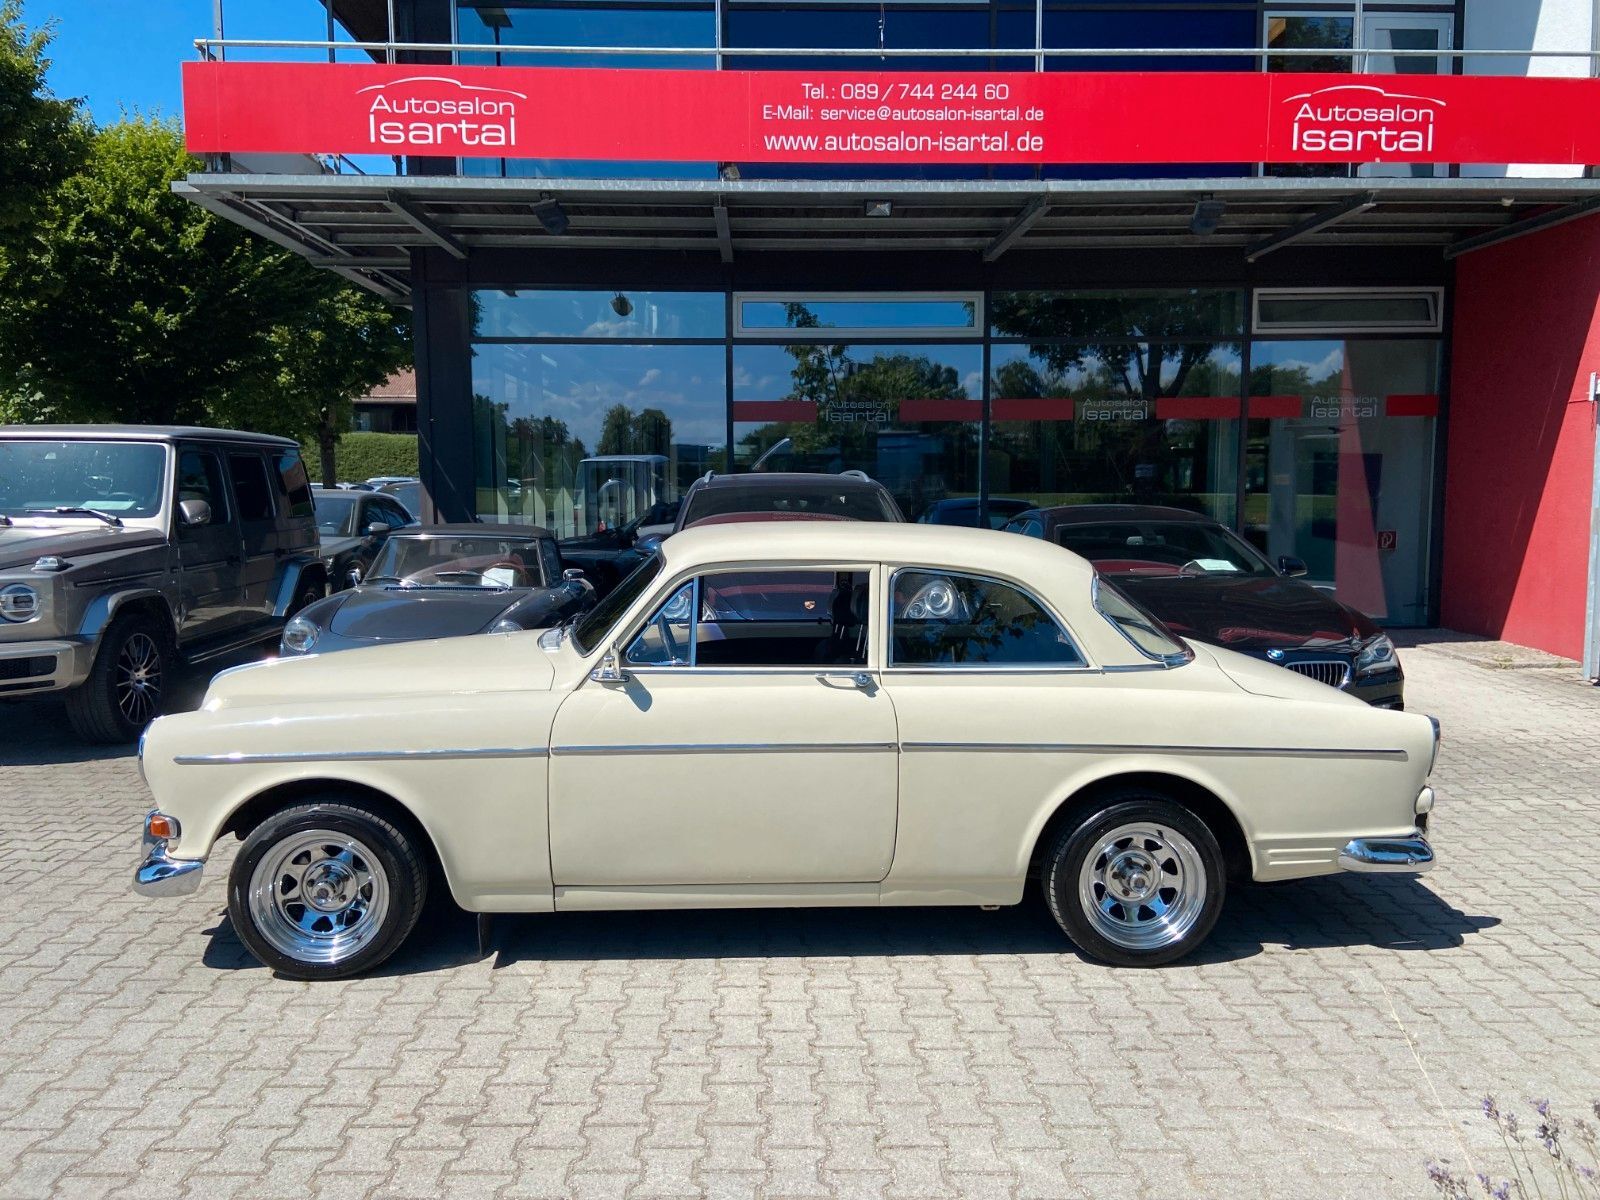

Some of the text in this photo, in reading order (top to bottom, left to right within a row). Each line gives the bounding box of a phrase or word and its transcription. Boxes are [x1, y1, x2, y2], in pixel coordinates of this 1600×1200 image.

[802, 83, 836, 99] Tel.:
[840, 84, 879, 99] 089
[898, 84, 935, 99] 744
[941, 84, 978, 99] 244
[984, 84, 1010, 99] 60
[370, 95, 515, 115] Autosalon
[762, 105, 1044, 121] E-Mail: service@autosalon-isartal.de
[1294, 102, 1434, 122] Autosalon
[369, 114, 515, 146] Isartal
[1292, 123, 1434, 152] Isartal
[764, 131, 1044, 151] www.autosalon-isartal.de
[825, 409, 891, 422] Isartal
[1082, 406, 1148, 421] Isartal
[1310, 404, 1377, 418] Isartal
